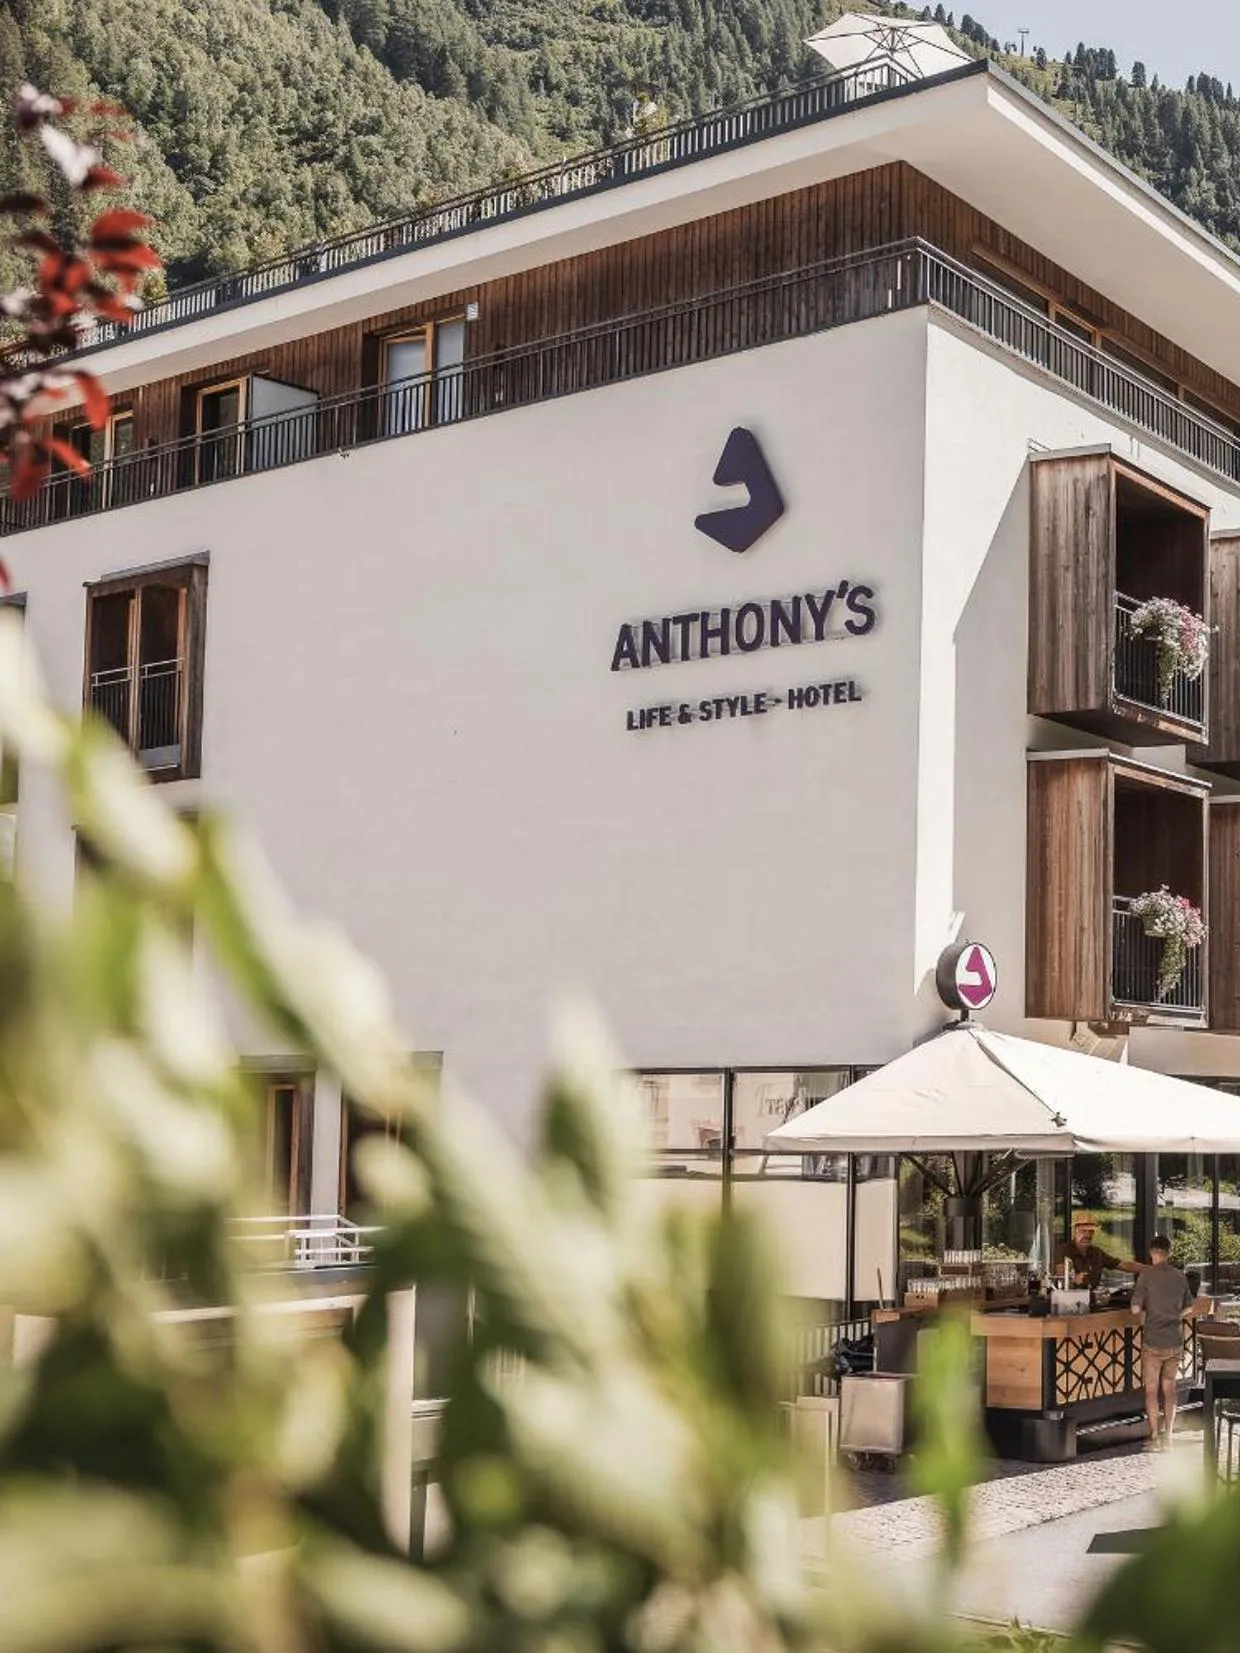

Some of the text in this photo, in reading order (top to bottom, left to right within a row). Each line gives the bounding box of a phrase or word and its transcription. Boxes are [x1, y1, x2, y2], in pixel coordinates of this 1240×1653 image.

[611, 580, 875, 672] ANTHONY'S
[626, 681, 862, 731] LIFE & STYLE HOTEL
